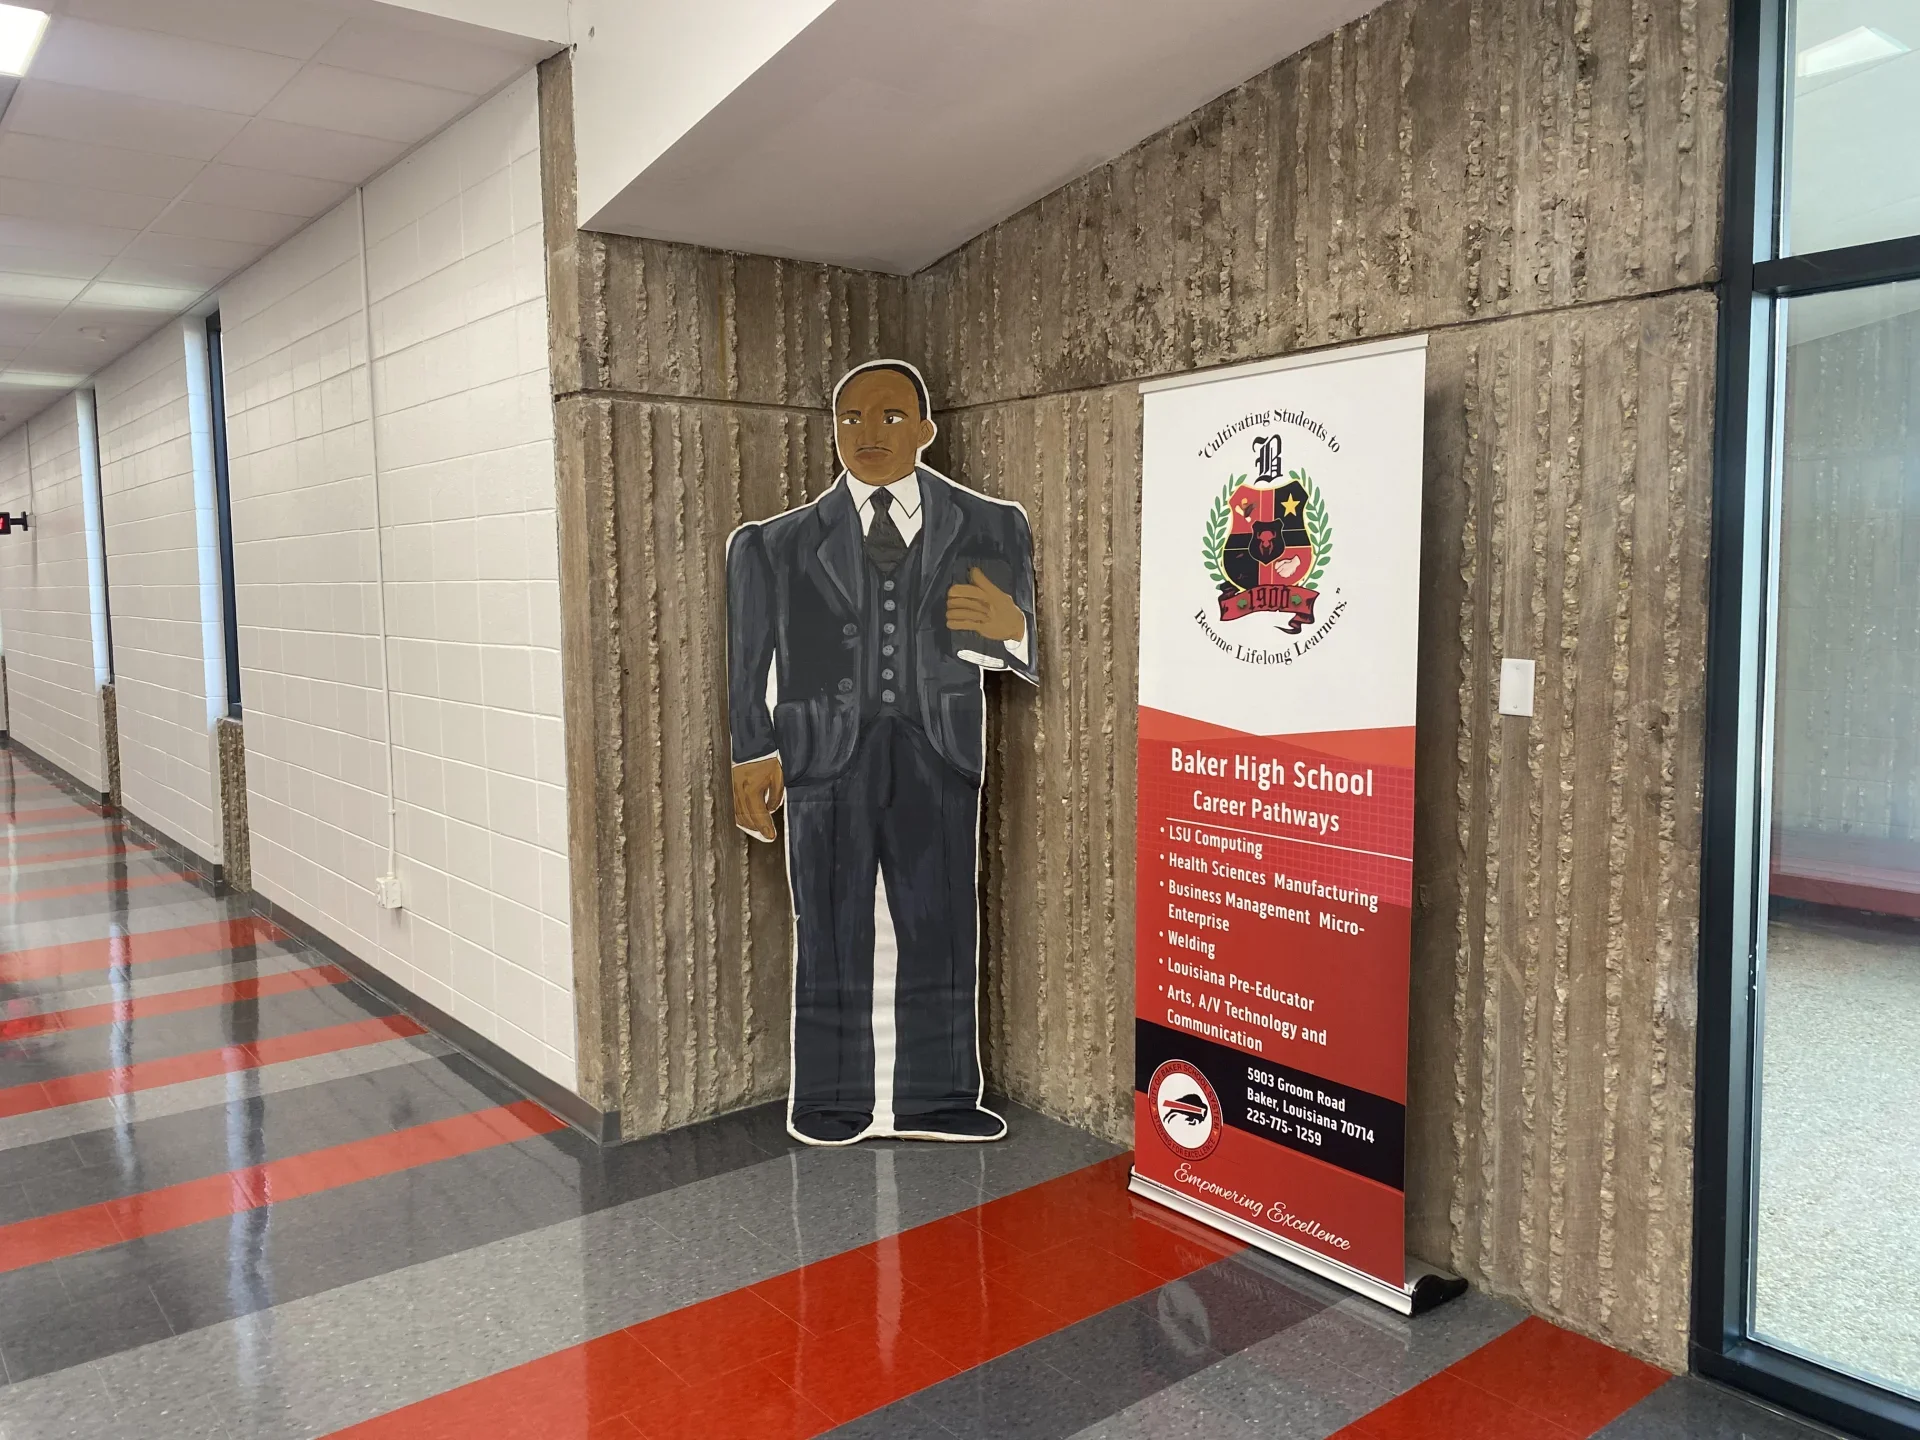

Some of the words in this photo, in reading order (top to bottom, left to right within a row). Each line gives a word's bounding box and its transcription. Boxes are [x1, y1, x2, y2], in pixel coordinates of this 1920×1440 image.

[1274, 408, 1327, 441] Students
[1328, 435, 1340, 452] to
[1252, 434, 1283, 485] B
[1249, 586, 1290, 609] 1900
[1194, 608, 1233, 653] Become
[1236, 644, 1292, 665] Lifelong
[1172, 748, 1227, 778] Baker
[1235, 755, 1285, 790] High
[1294, 762, 1372, 797] School
[1194, 790, 1246, 816] Career
[1252, 799, 1339, 835] Pathways
[1170, 825, 1190, 842] LSU
[1195, 830, 1263, 860] Computing
[1169, 853, 1207, 873] Health
[1212, 861, 1266, 885] Sciences
[1275, 873, 1378, 913] Manufacturing
[1169, 880, 1221, 904] Business
[1226, 892, 1310, 925] Management
[1320, 912, 1364, 935] Micro-
[1169, 904, 1229, 931] Enterprise
[1168, 930, 1215, 959] Welding
[1168, 957, 1225, 986] Louisiana
[1230, 974, 1314, 1012] Pre-Educator
[1167, 1009, 1263, 1052] Communication
[1168, 985, 1194, 1008] Arts,
[1199, 993, 1220, 1013] A/V
[1225, 1000, 1297, 1039] Technology
[1302, 1026, 1326, 1046] and
[1155, 1076, 1162, 1085] OF
[1161, 1063, 1182, 1076] BAKER
[1184, 1065, 1207, 1090] SCHOOL
[1208, 1091, 1219, 1130] SYSTEM
[1248, 1067, 1274, 1088] 5903
[1278, 1078, 1314, 1101] Groom
[1318, 1092, 1345, 1112] Road
[1154, 1115, 1172, 1146] STRIVING
[1172, 1143, 1184, 1155] FOR
[1185, 1138, 1215, 1158] EXCELLENCE
[1247, 1088, 1279, 1112] Baker,
[1283, 1100, 1337, 1130] Louisiana
[1341, 1120, 1374, 1143] 70714
[1247, 1108, 1292, 1135] 225-775-
[1296, 1125, 1322, 1146] 1259
[1174, 1163, 1263, 1217] Empowering
[1267, 1201, 1350, 1250] Excellence
